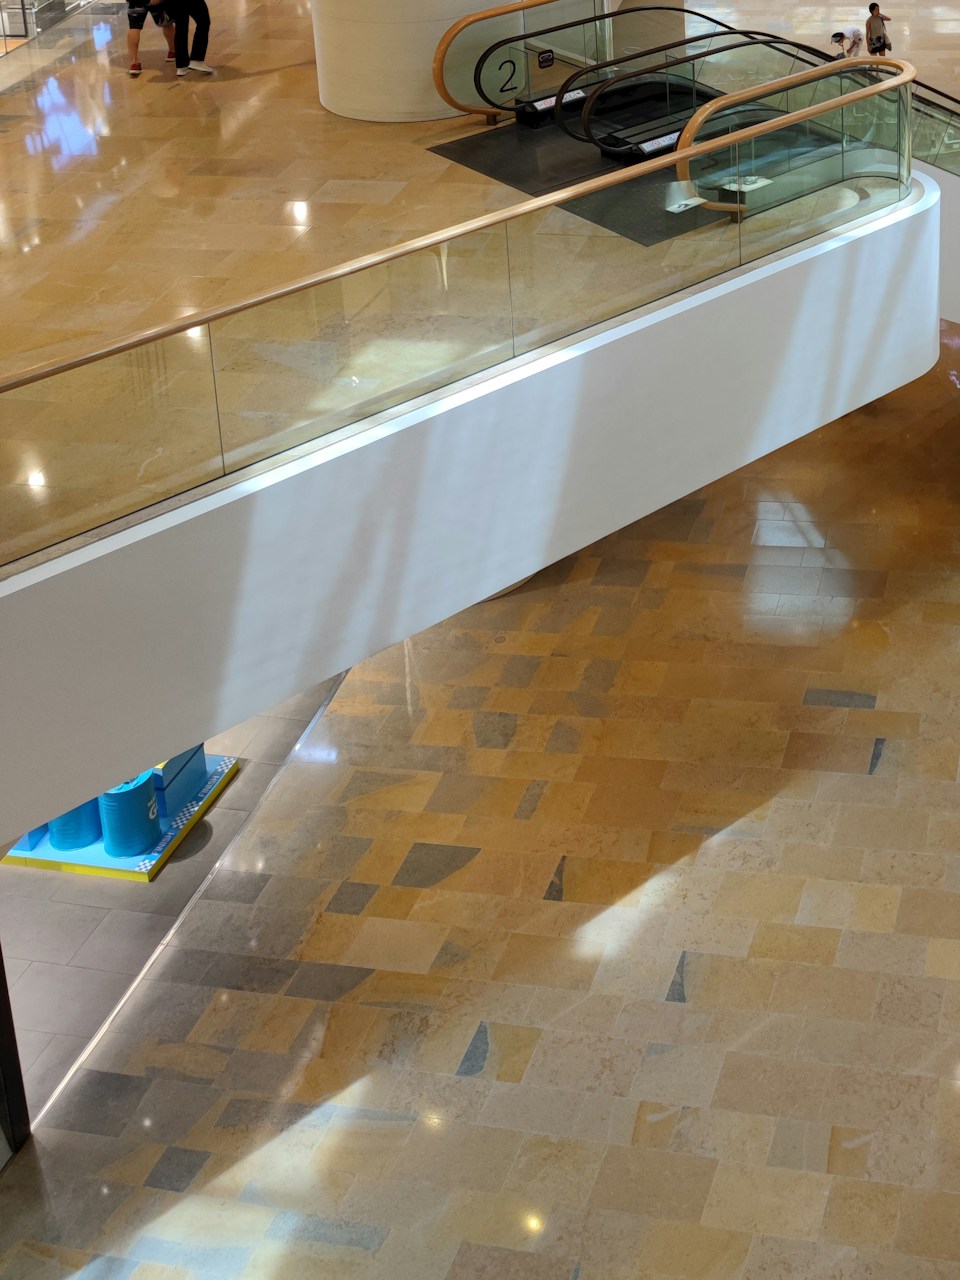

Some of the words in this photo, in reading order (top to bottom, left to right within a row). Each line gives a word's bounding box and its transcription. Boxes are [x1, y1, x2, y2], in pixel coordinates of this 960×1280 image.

[498, 60, 518, 93] 2
[198, 775, 220, 798] FINISH
[152, 832, 176, 855] FINISH
